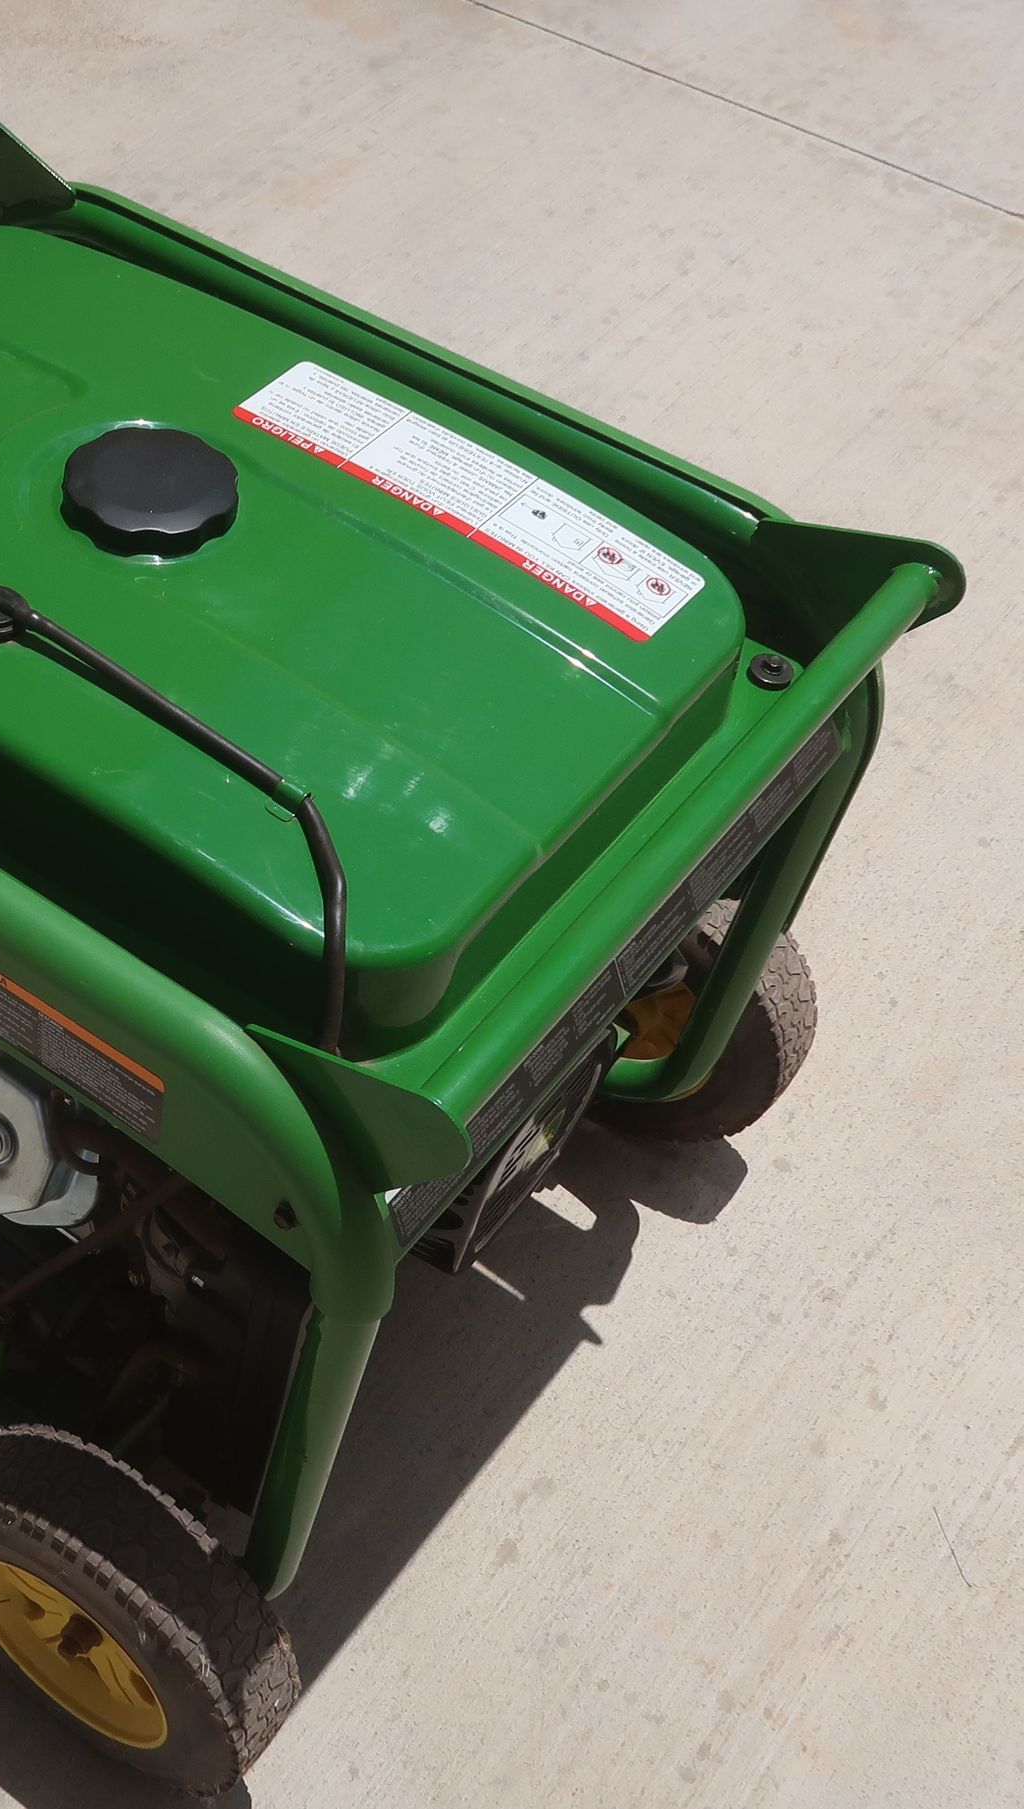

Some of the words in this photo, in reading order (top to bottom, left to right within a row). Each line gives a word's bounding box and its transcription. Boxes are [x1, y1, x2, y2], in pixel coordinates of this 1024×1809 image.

[252, 416, 313, 453] PELIGRO
[371, 475, 434, 514] DANGER
[522, 558, 586, 602] DANGER
